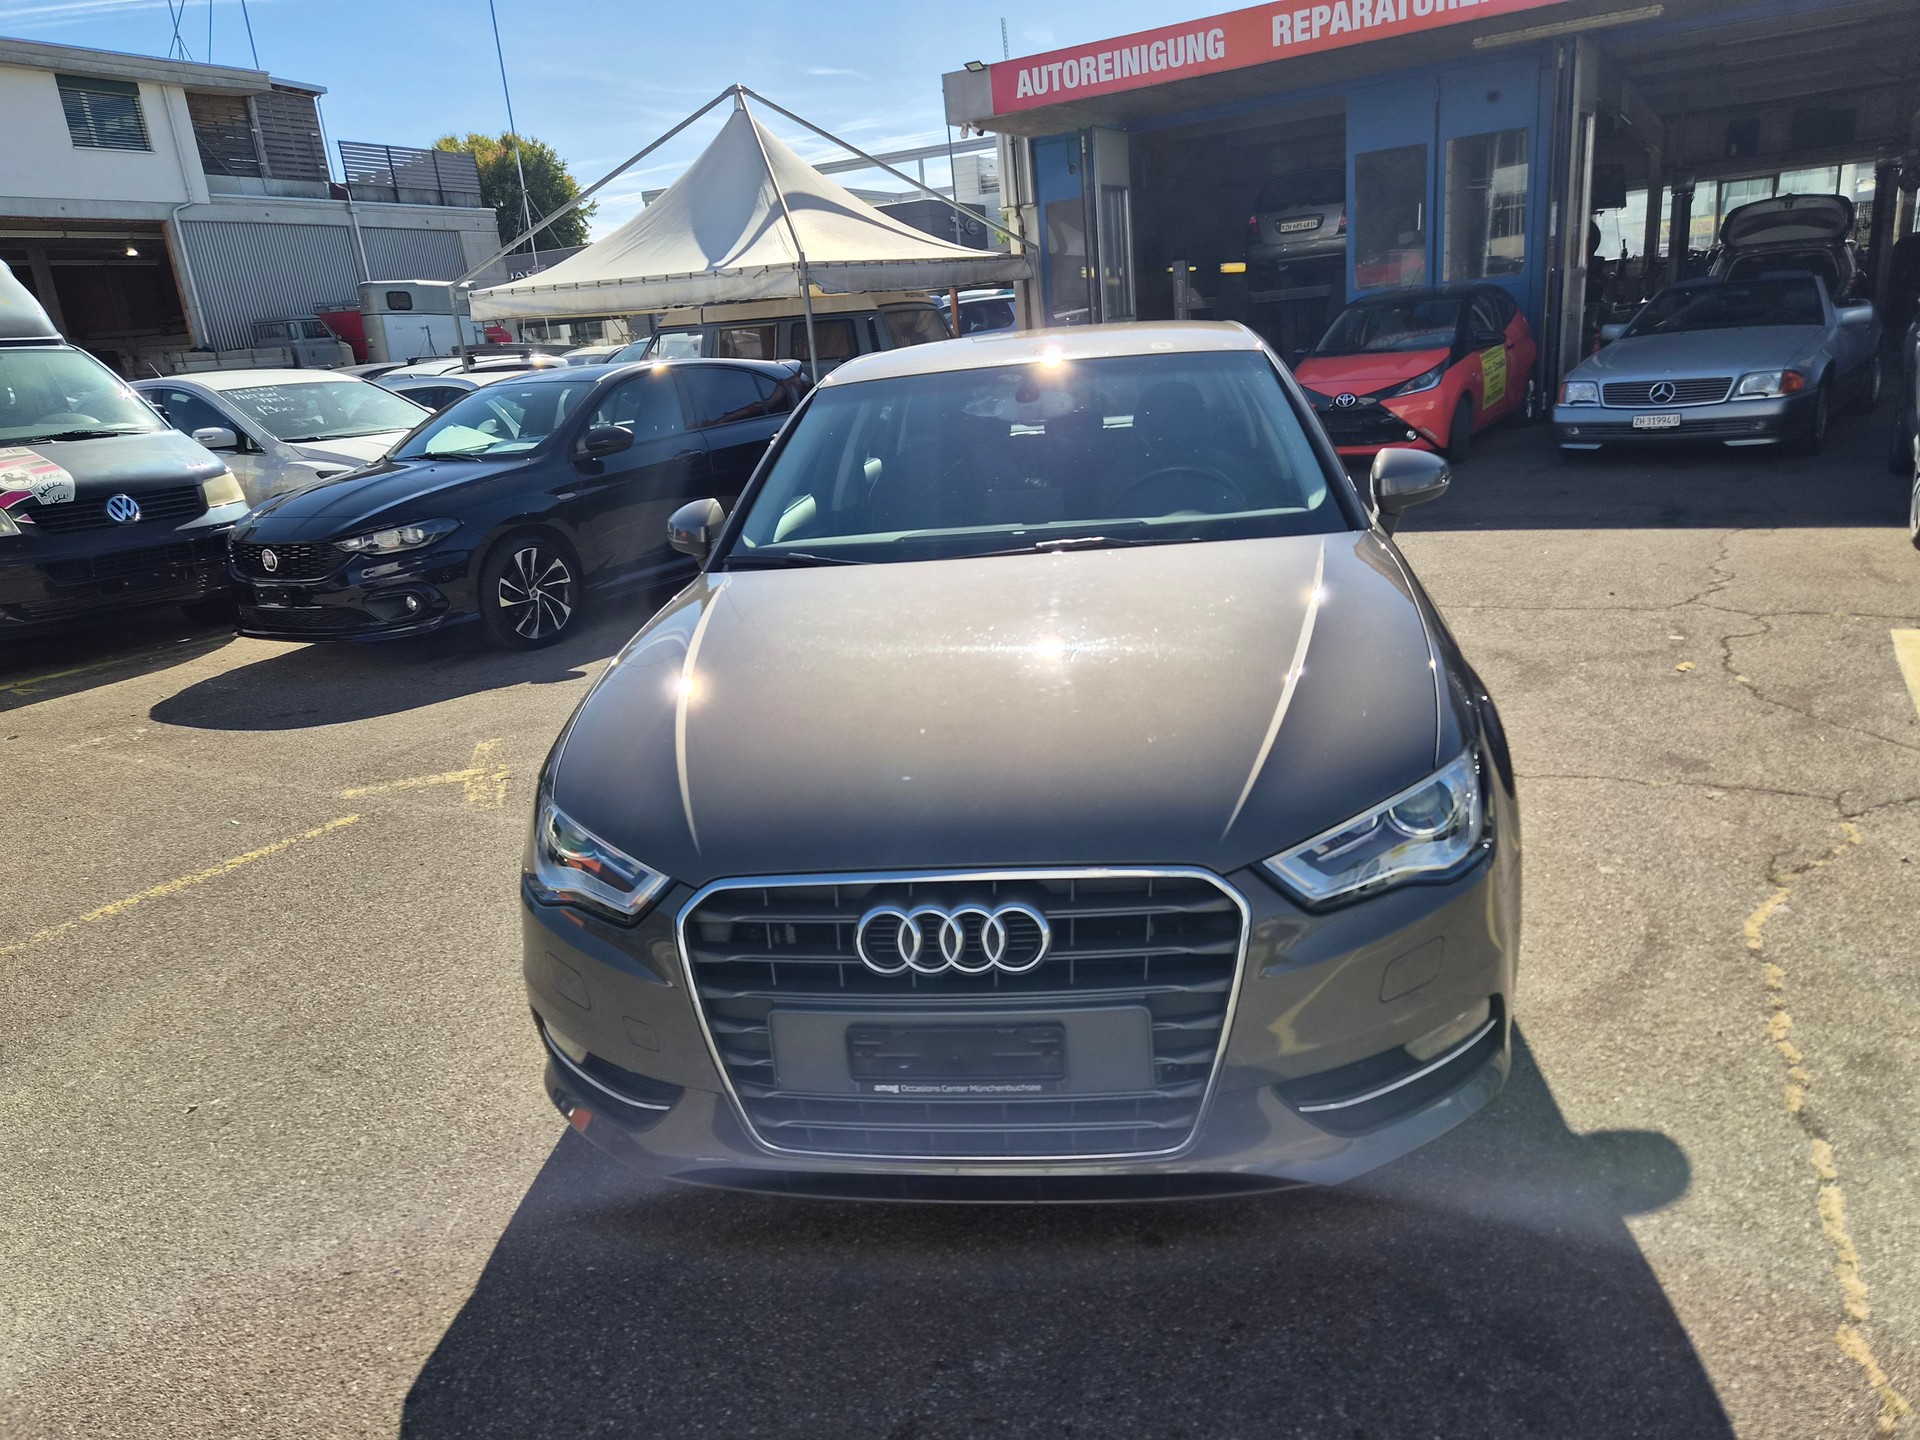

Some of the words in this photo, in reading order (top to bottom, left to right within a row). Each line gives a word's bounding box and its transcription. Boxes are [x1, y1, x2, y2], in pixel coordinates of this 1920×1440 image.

[1017, 28, 1225, 98] AUTOREINIGUNG
[1272, 0, 1490, 47] REPARATU
[1634, 417, 1645, 426] ZH
[1646, 416, 1672, 426] 31994
[874, 1084, 899, 1094] amag
[900, 1084, 941, 1093] Occasions
[941, 1084, 969, 1093] Center
